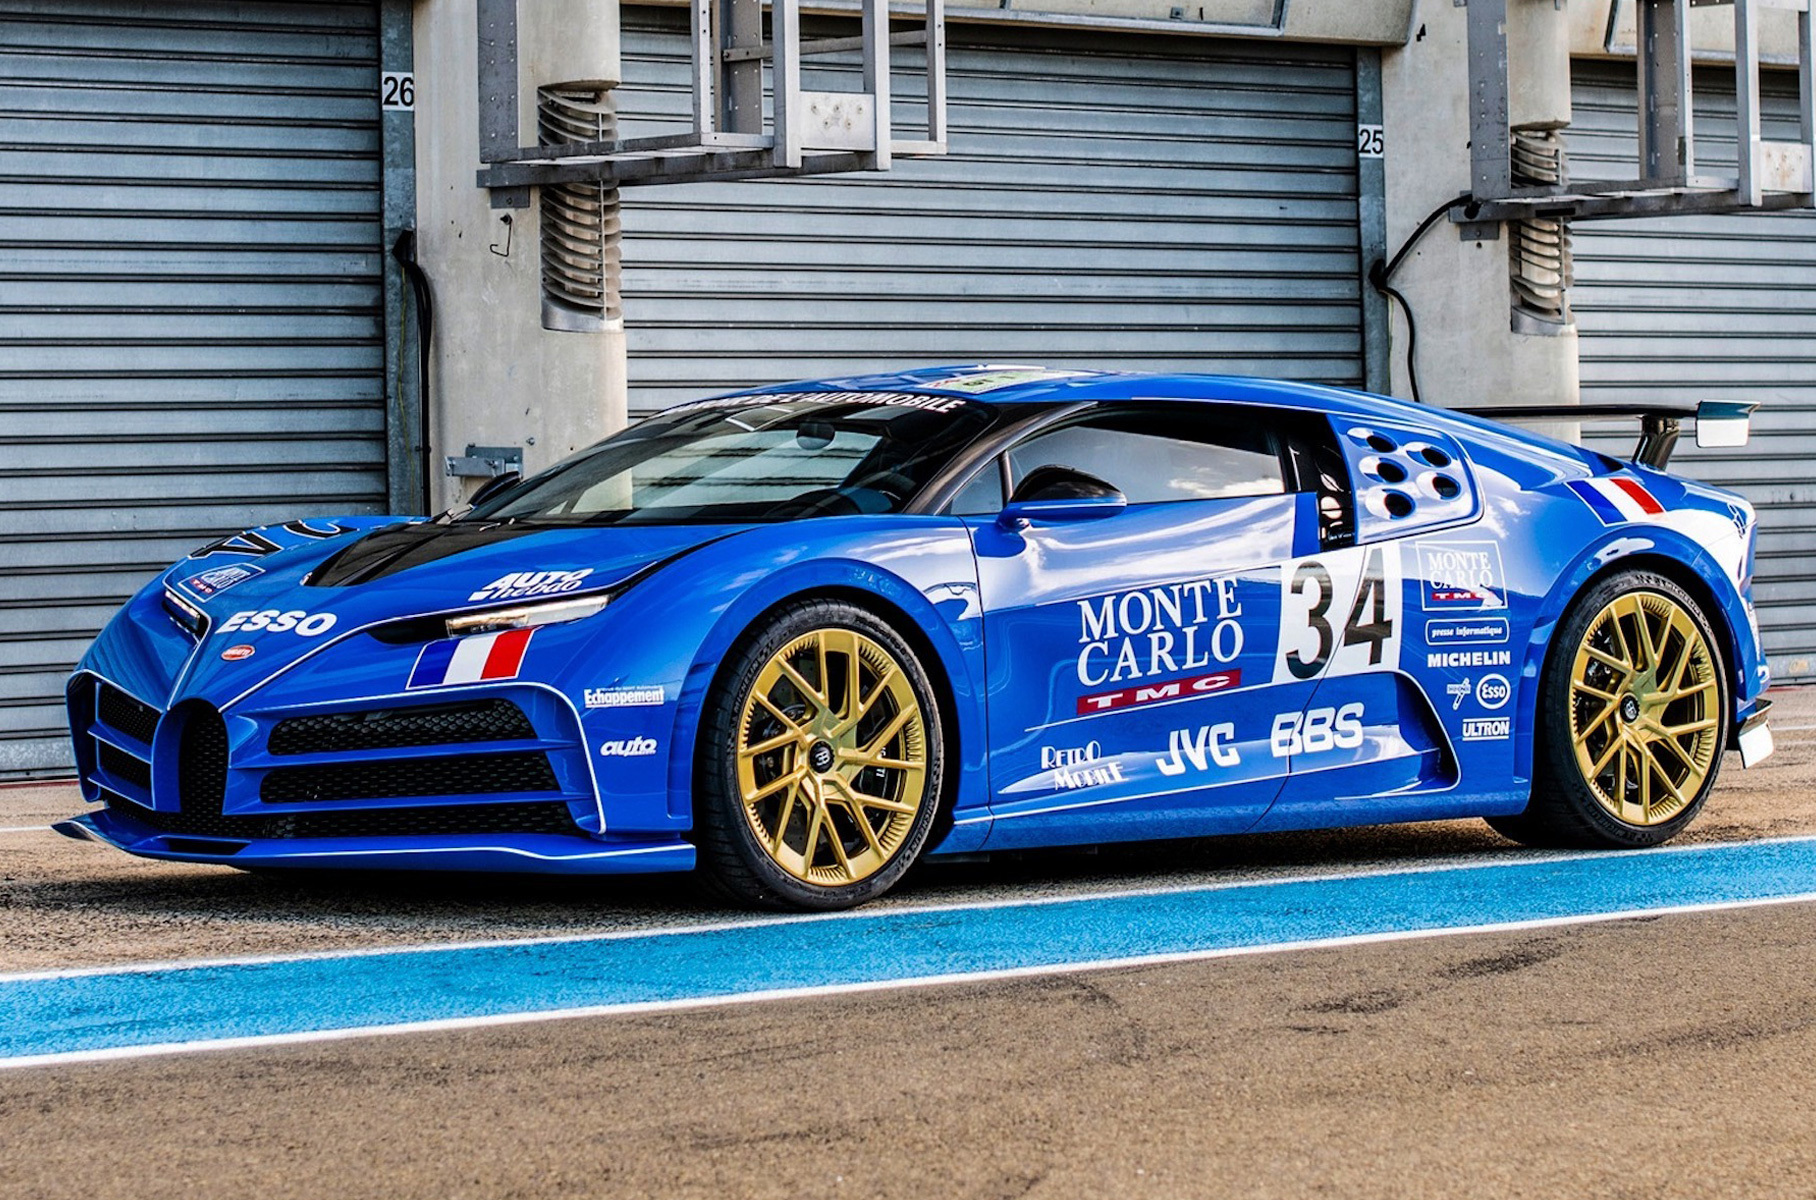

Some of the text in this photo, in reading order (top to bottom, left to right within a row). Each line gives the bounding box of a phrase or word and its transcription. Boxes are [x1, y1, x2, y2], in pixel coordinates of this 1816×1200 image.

[383, 76, 415, 107] 26
[1359, 129, 1384, 154] 25
[1427, 551, 1492, 571] MONTE
[482, 568, 595, 591] AUTO
[1430, 569, 1494, 590] CARLO
[1077, 575, 1243, 643] MONTE
[1286, 548, 1393, 680] 34
[215, 609, 338, 637] ESSO
[1077, 619, 1244, 687] CARLO
[1427, 651, 1511, 668] MICHELIN
[584, 687, 664, 706] Echappement
[1087, 675, 1231, 709] TMC
[1270, 702, 1365, 757] BBS
[1462, 721, 1510, 737] ULTRON
[600, 736, 658, 757] auto
[1155, 722, 1241, 776] JVC
